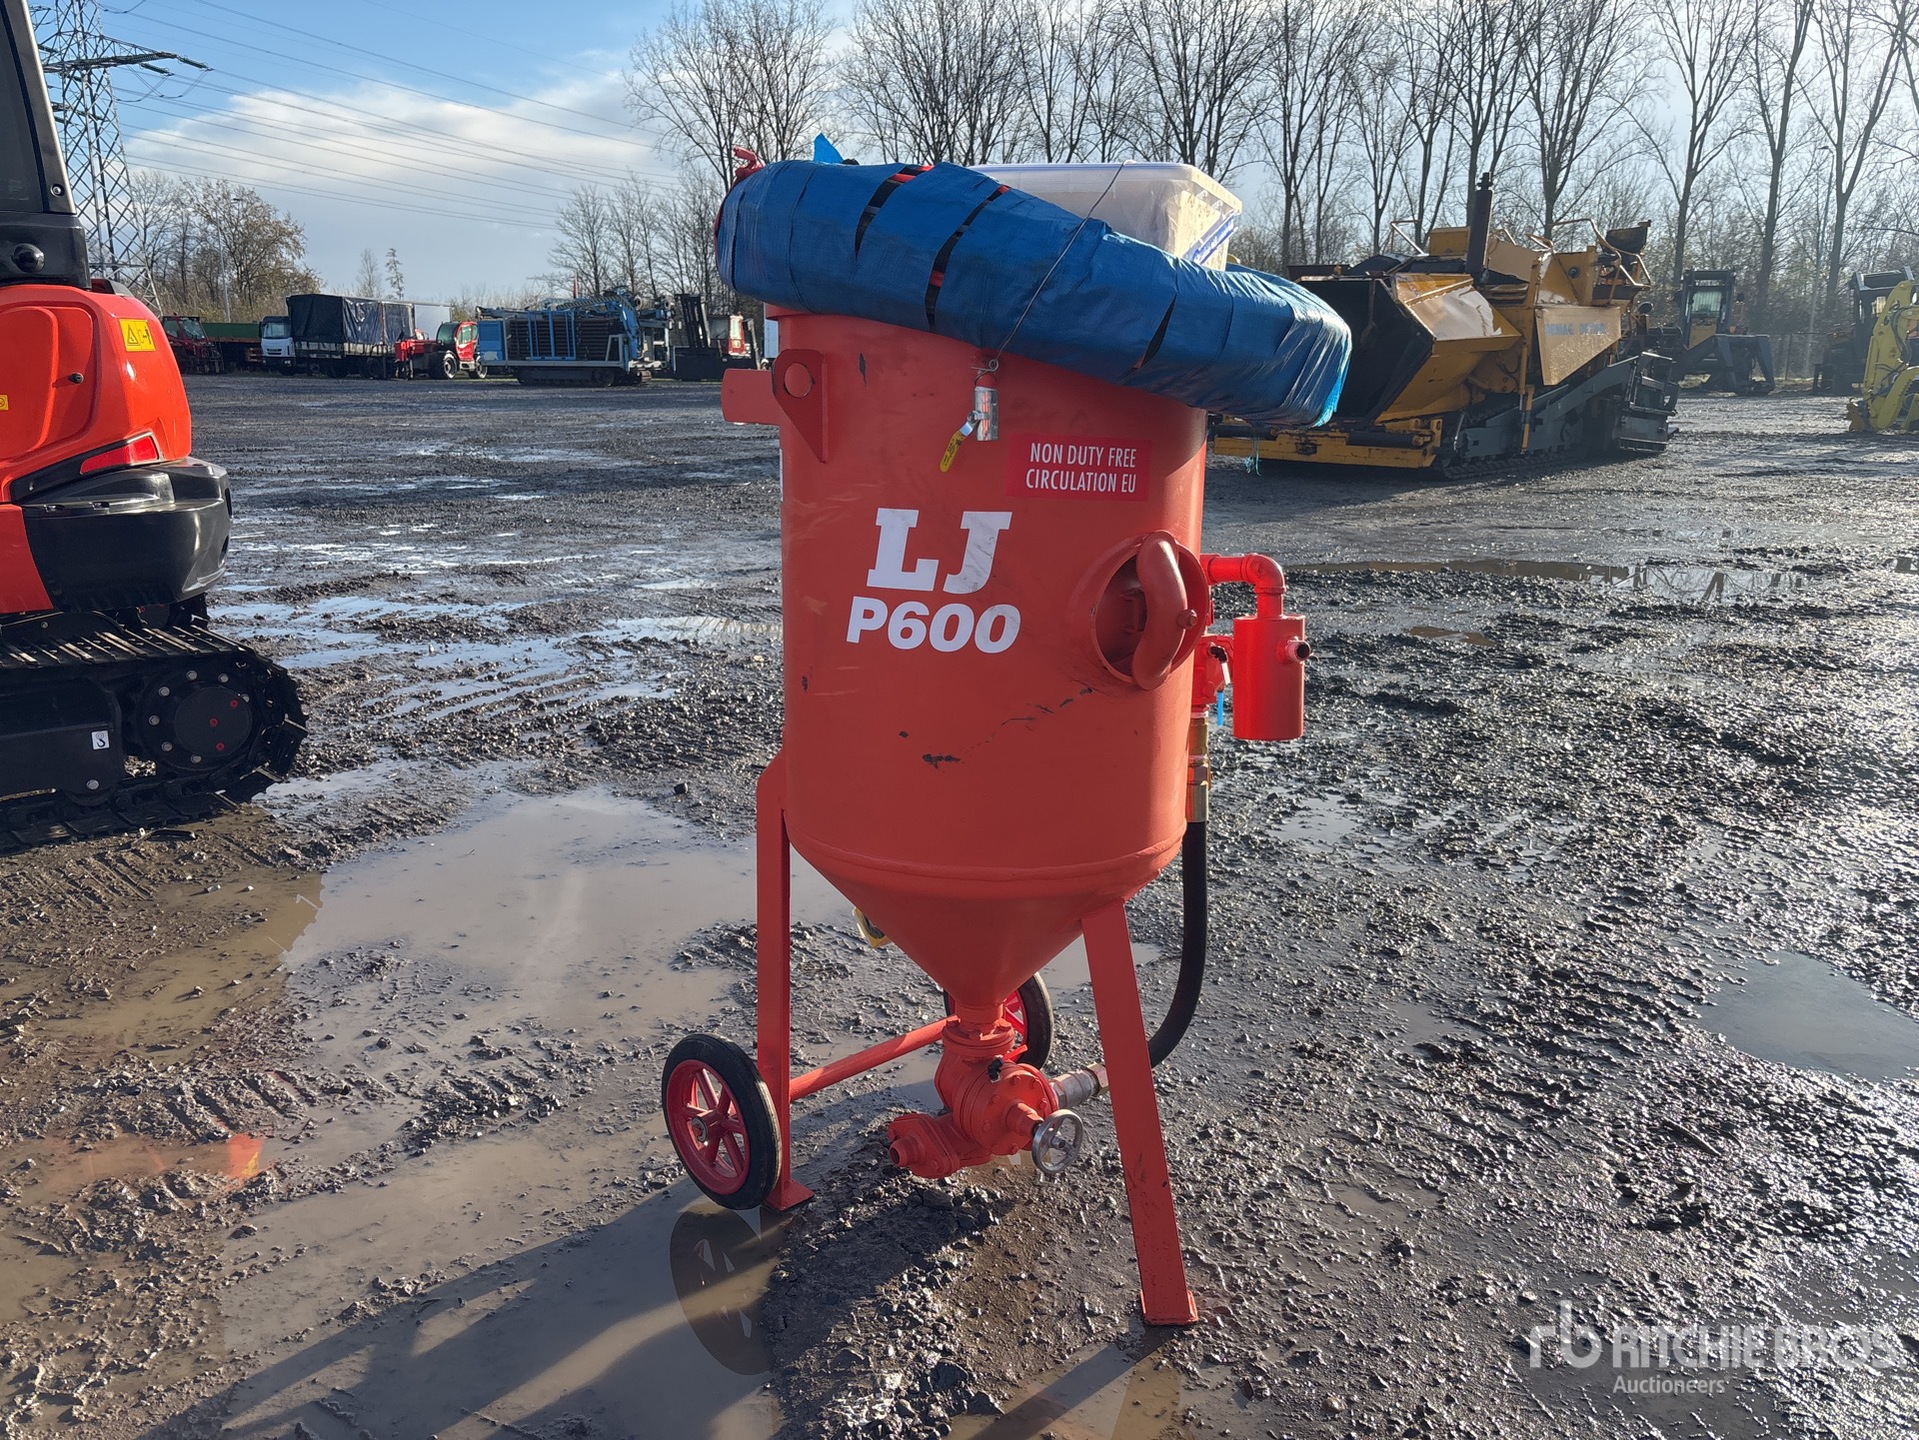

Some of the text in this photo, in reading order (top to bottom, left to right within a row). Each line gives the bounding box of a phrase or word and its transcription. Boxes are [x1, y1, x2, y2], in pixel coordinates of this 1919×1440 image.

[1030, 442, 1137, 468] NON DUTY FREE
[1026, 468, 1137, 493] CIRCULATION EU
[866, 507, 1013, 595] LJ
[846, 595, 1022, 654] P600
